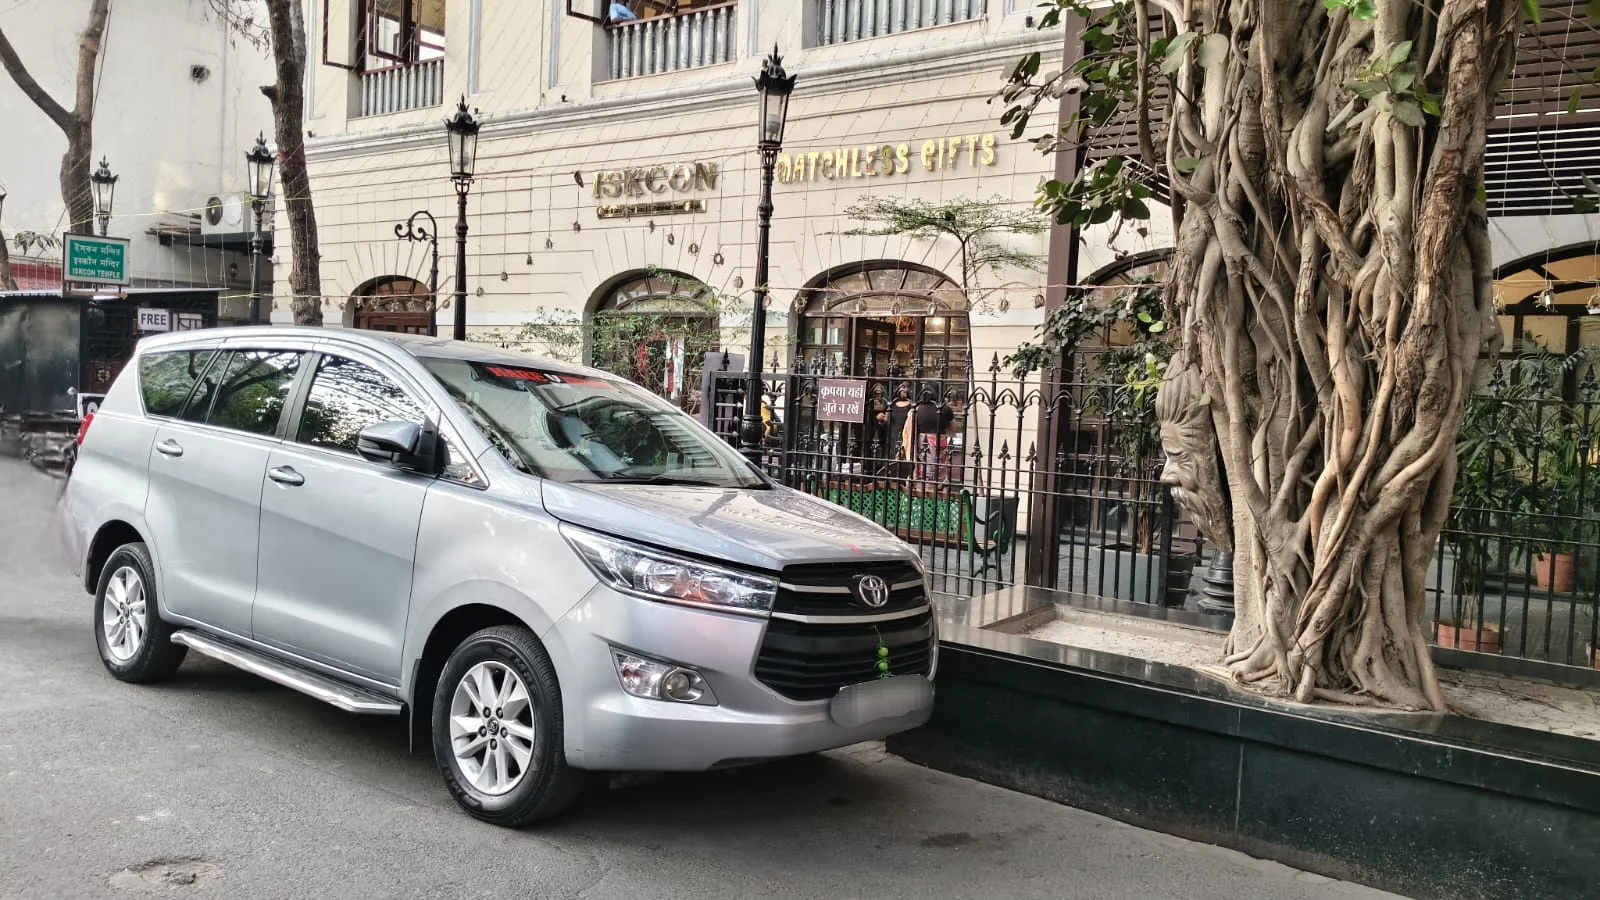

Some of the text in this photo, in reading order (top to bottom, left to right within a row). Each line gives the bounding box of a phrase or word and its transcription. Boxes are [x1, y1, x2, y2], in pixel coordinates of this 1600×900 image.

[921, 133, 995, 171] GIFTS
[593, 161, 718, 199] ISKCON
[72, 267, 121, 279] ISKCON TEMPLE
[140, 313, 167, 326] FREE
[821, 386, 845, 399] कृपया
[823, 400, 859, 416] जूते न रखें
